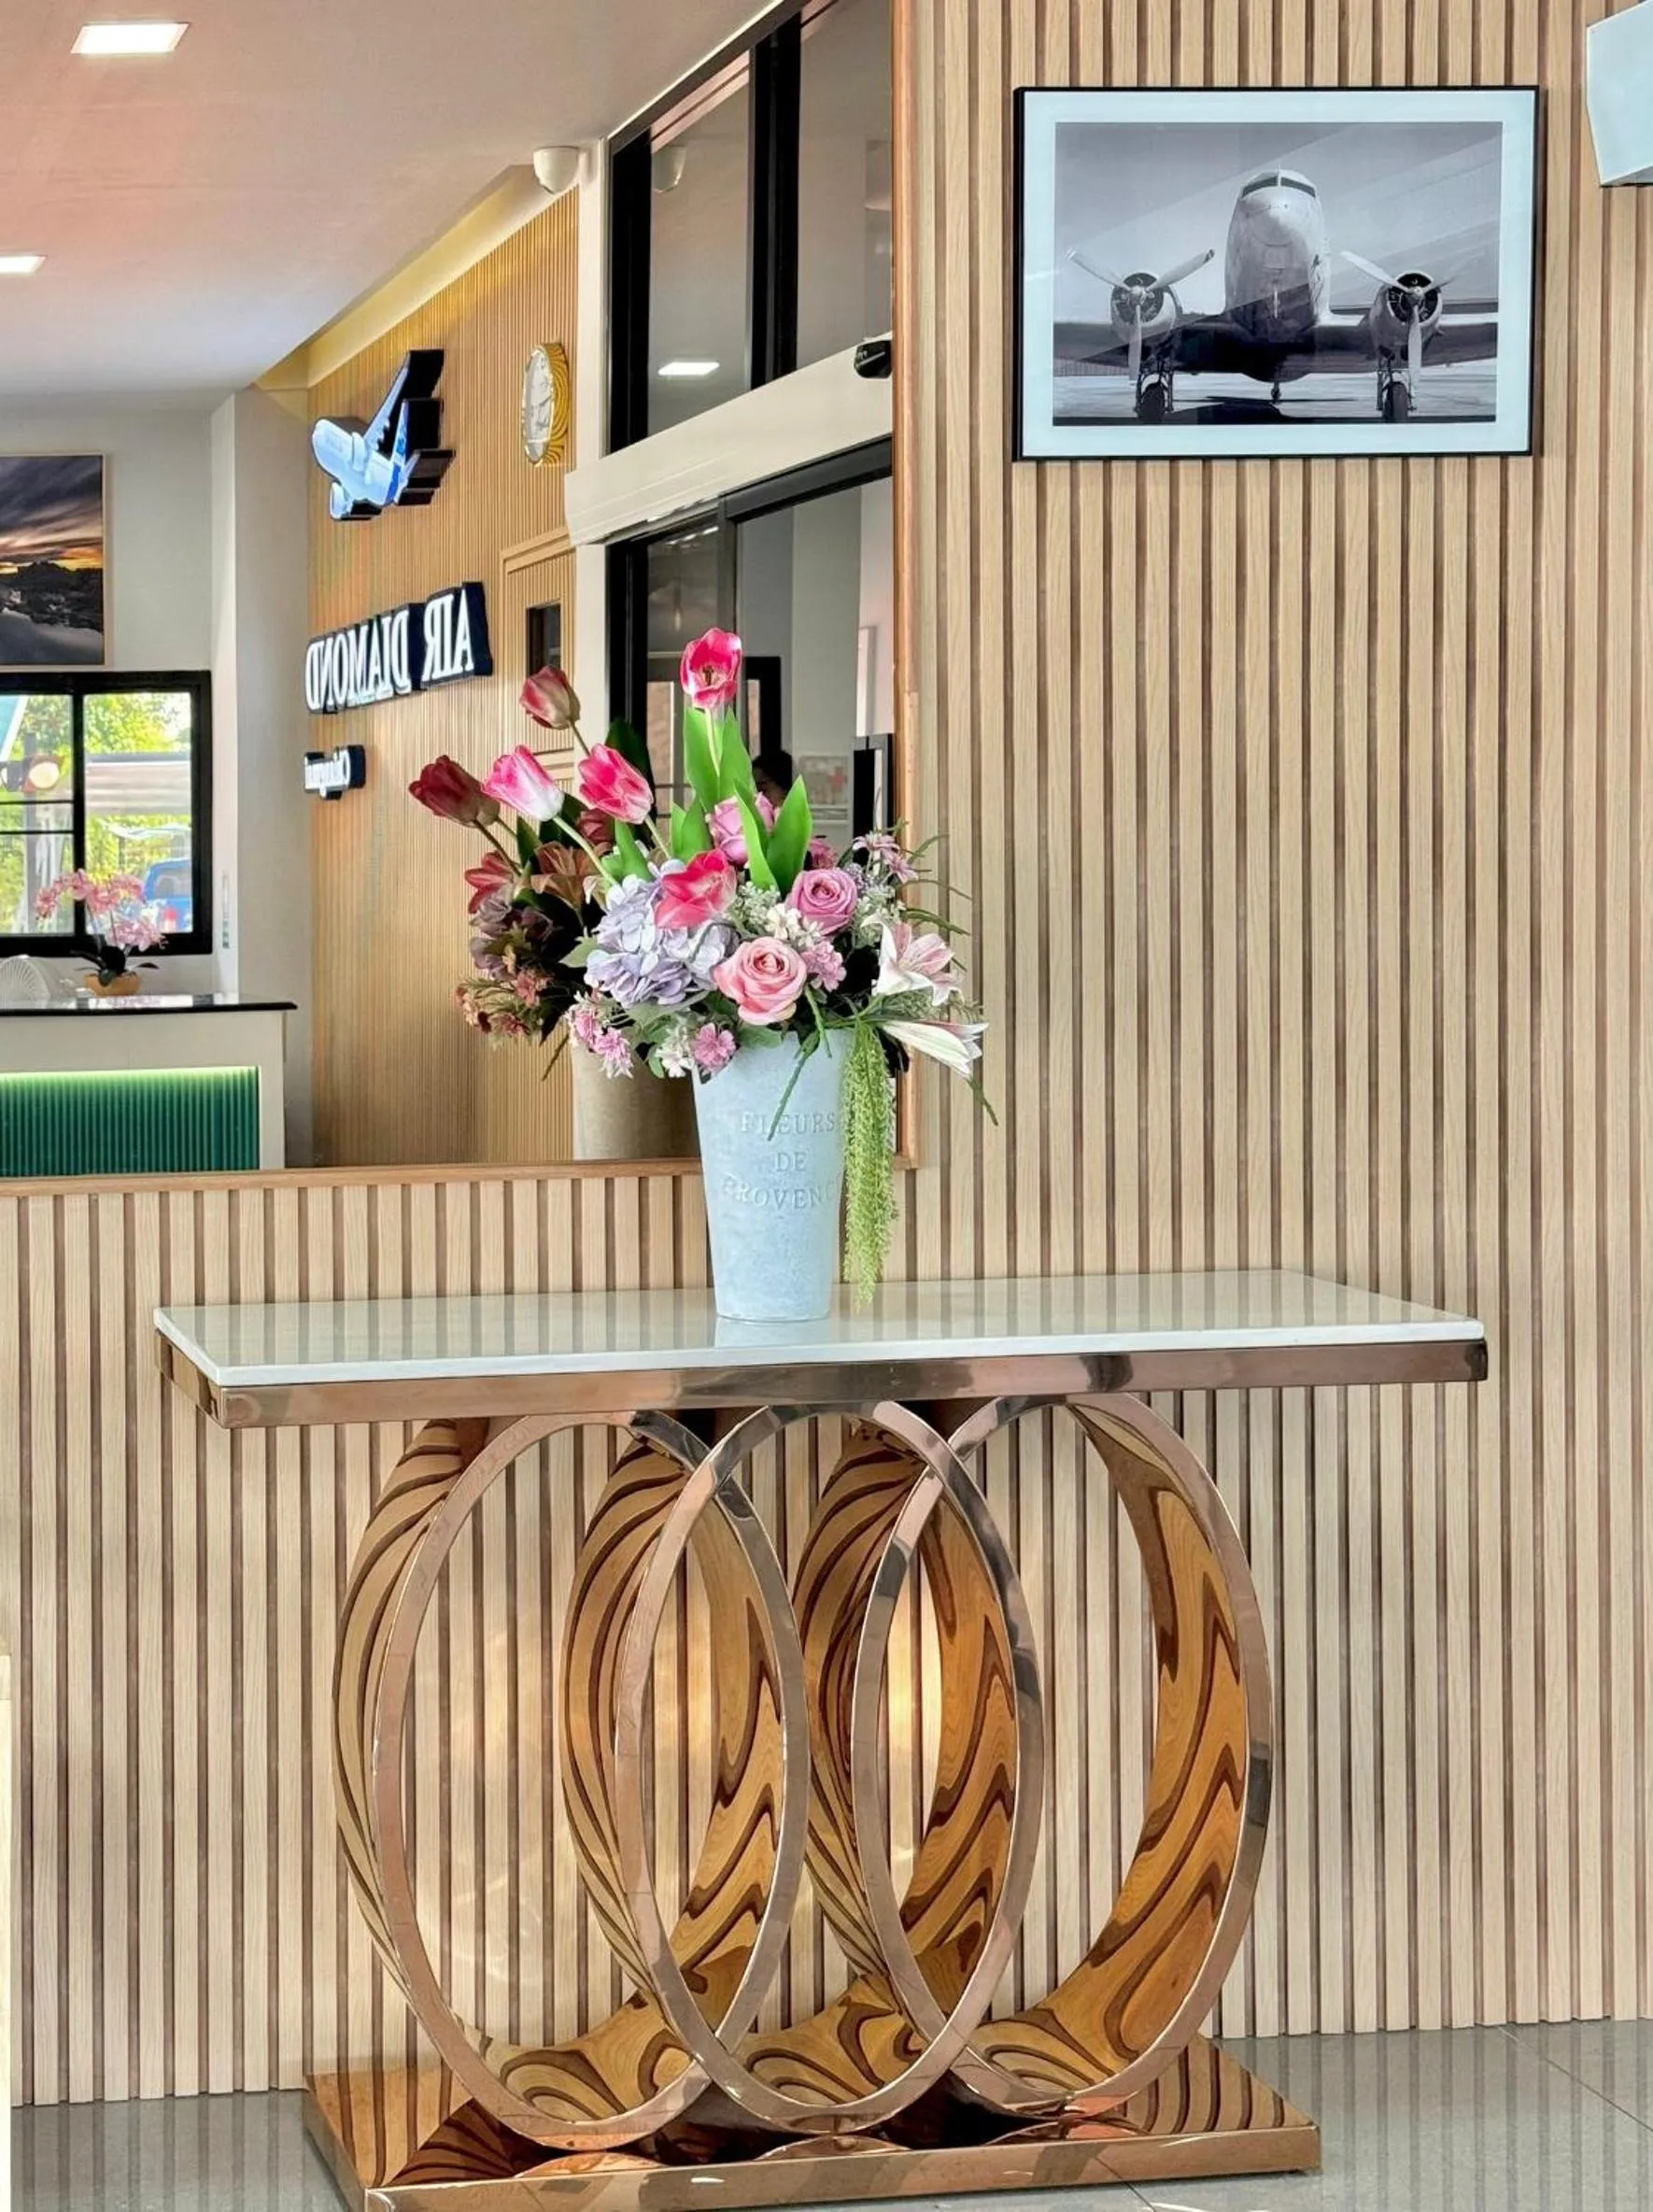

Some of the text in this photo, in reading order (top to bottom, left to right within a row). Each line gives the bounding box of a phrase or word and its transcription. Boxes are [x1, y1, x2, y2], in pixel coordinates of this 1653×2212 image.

[742, 1112, 836, 1135] FLEURS
[775, 1152, 807, 1172] DE
[722, 1175, 839, 1211] PROVENC
